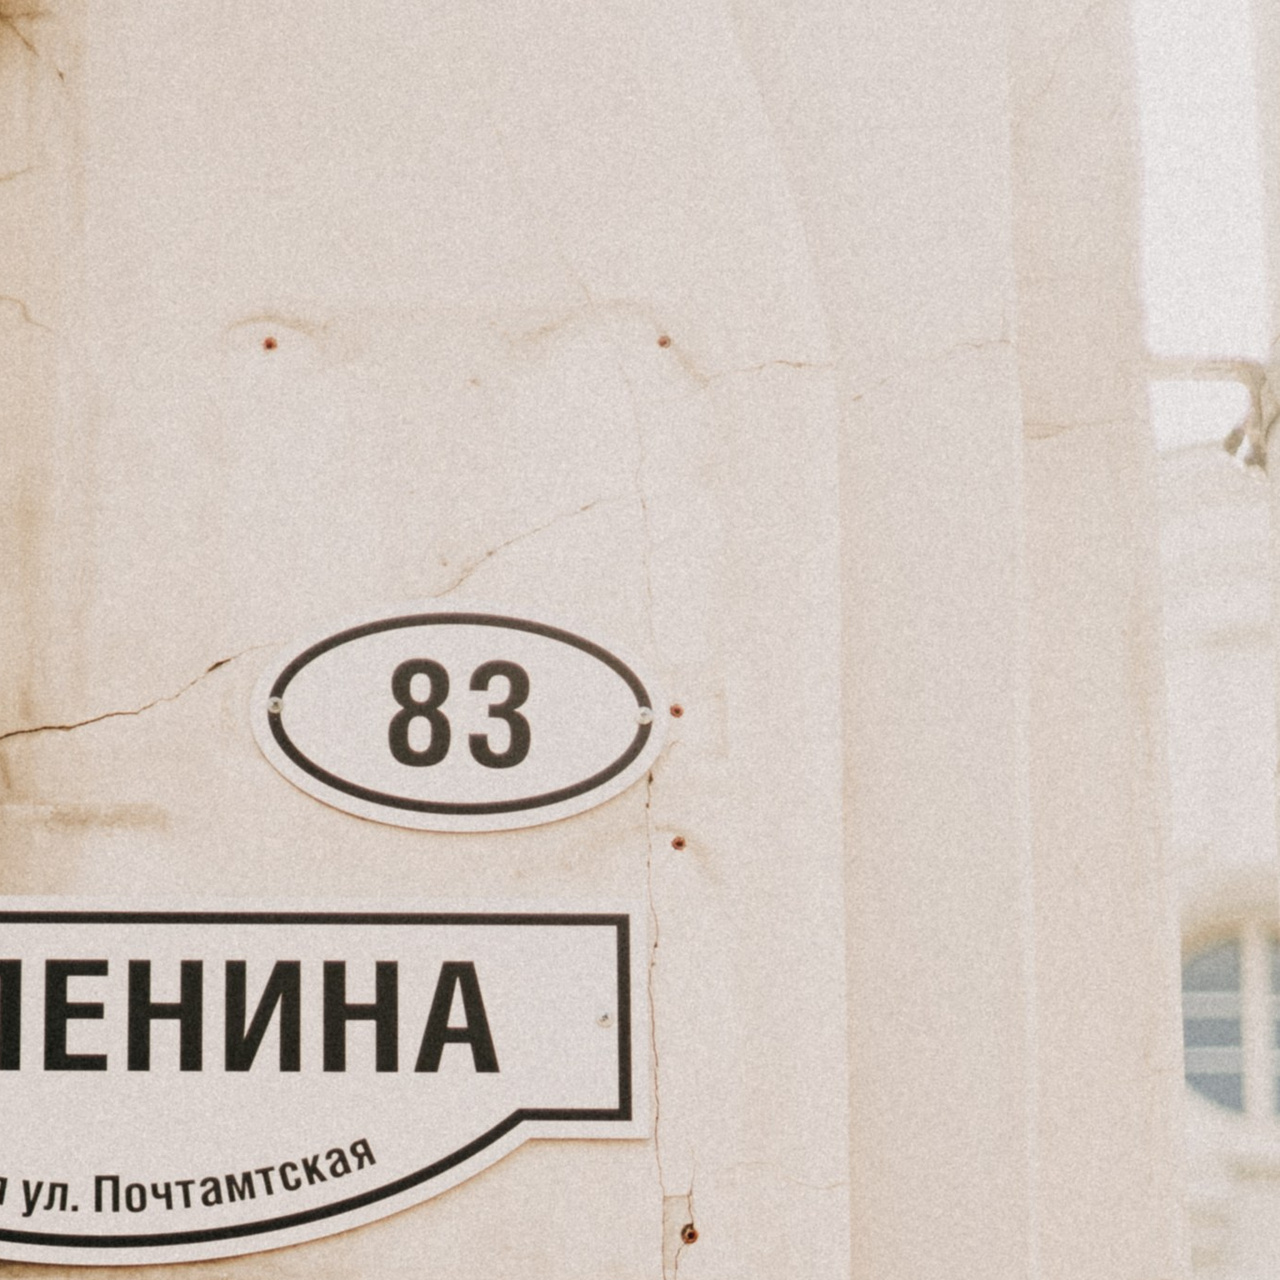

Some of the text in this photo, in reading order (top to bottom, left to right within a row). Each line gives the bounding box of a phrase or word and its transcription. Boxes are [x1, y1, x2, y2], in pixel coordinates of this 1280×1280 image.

[389, 659, 531, 769] 83
[22, 1180, 78, 1217] ул.
[94, 1138, 379, 1214] Почтамтская
